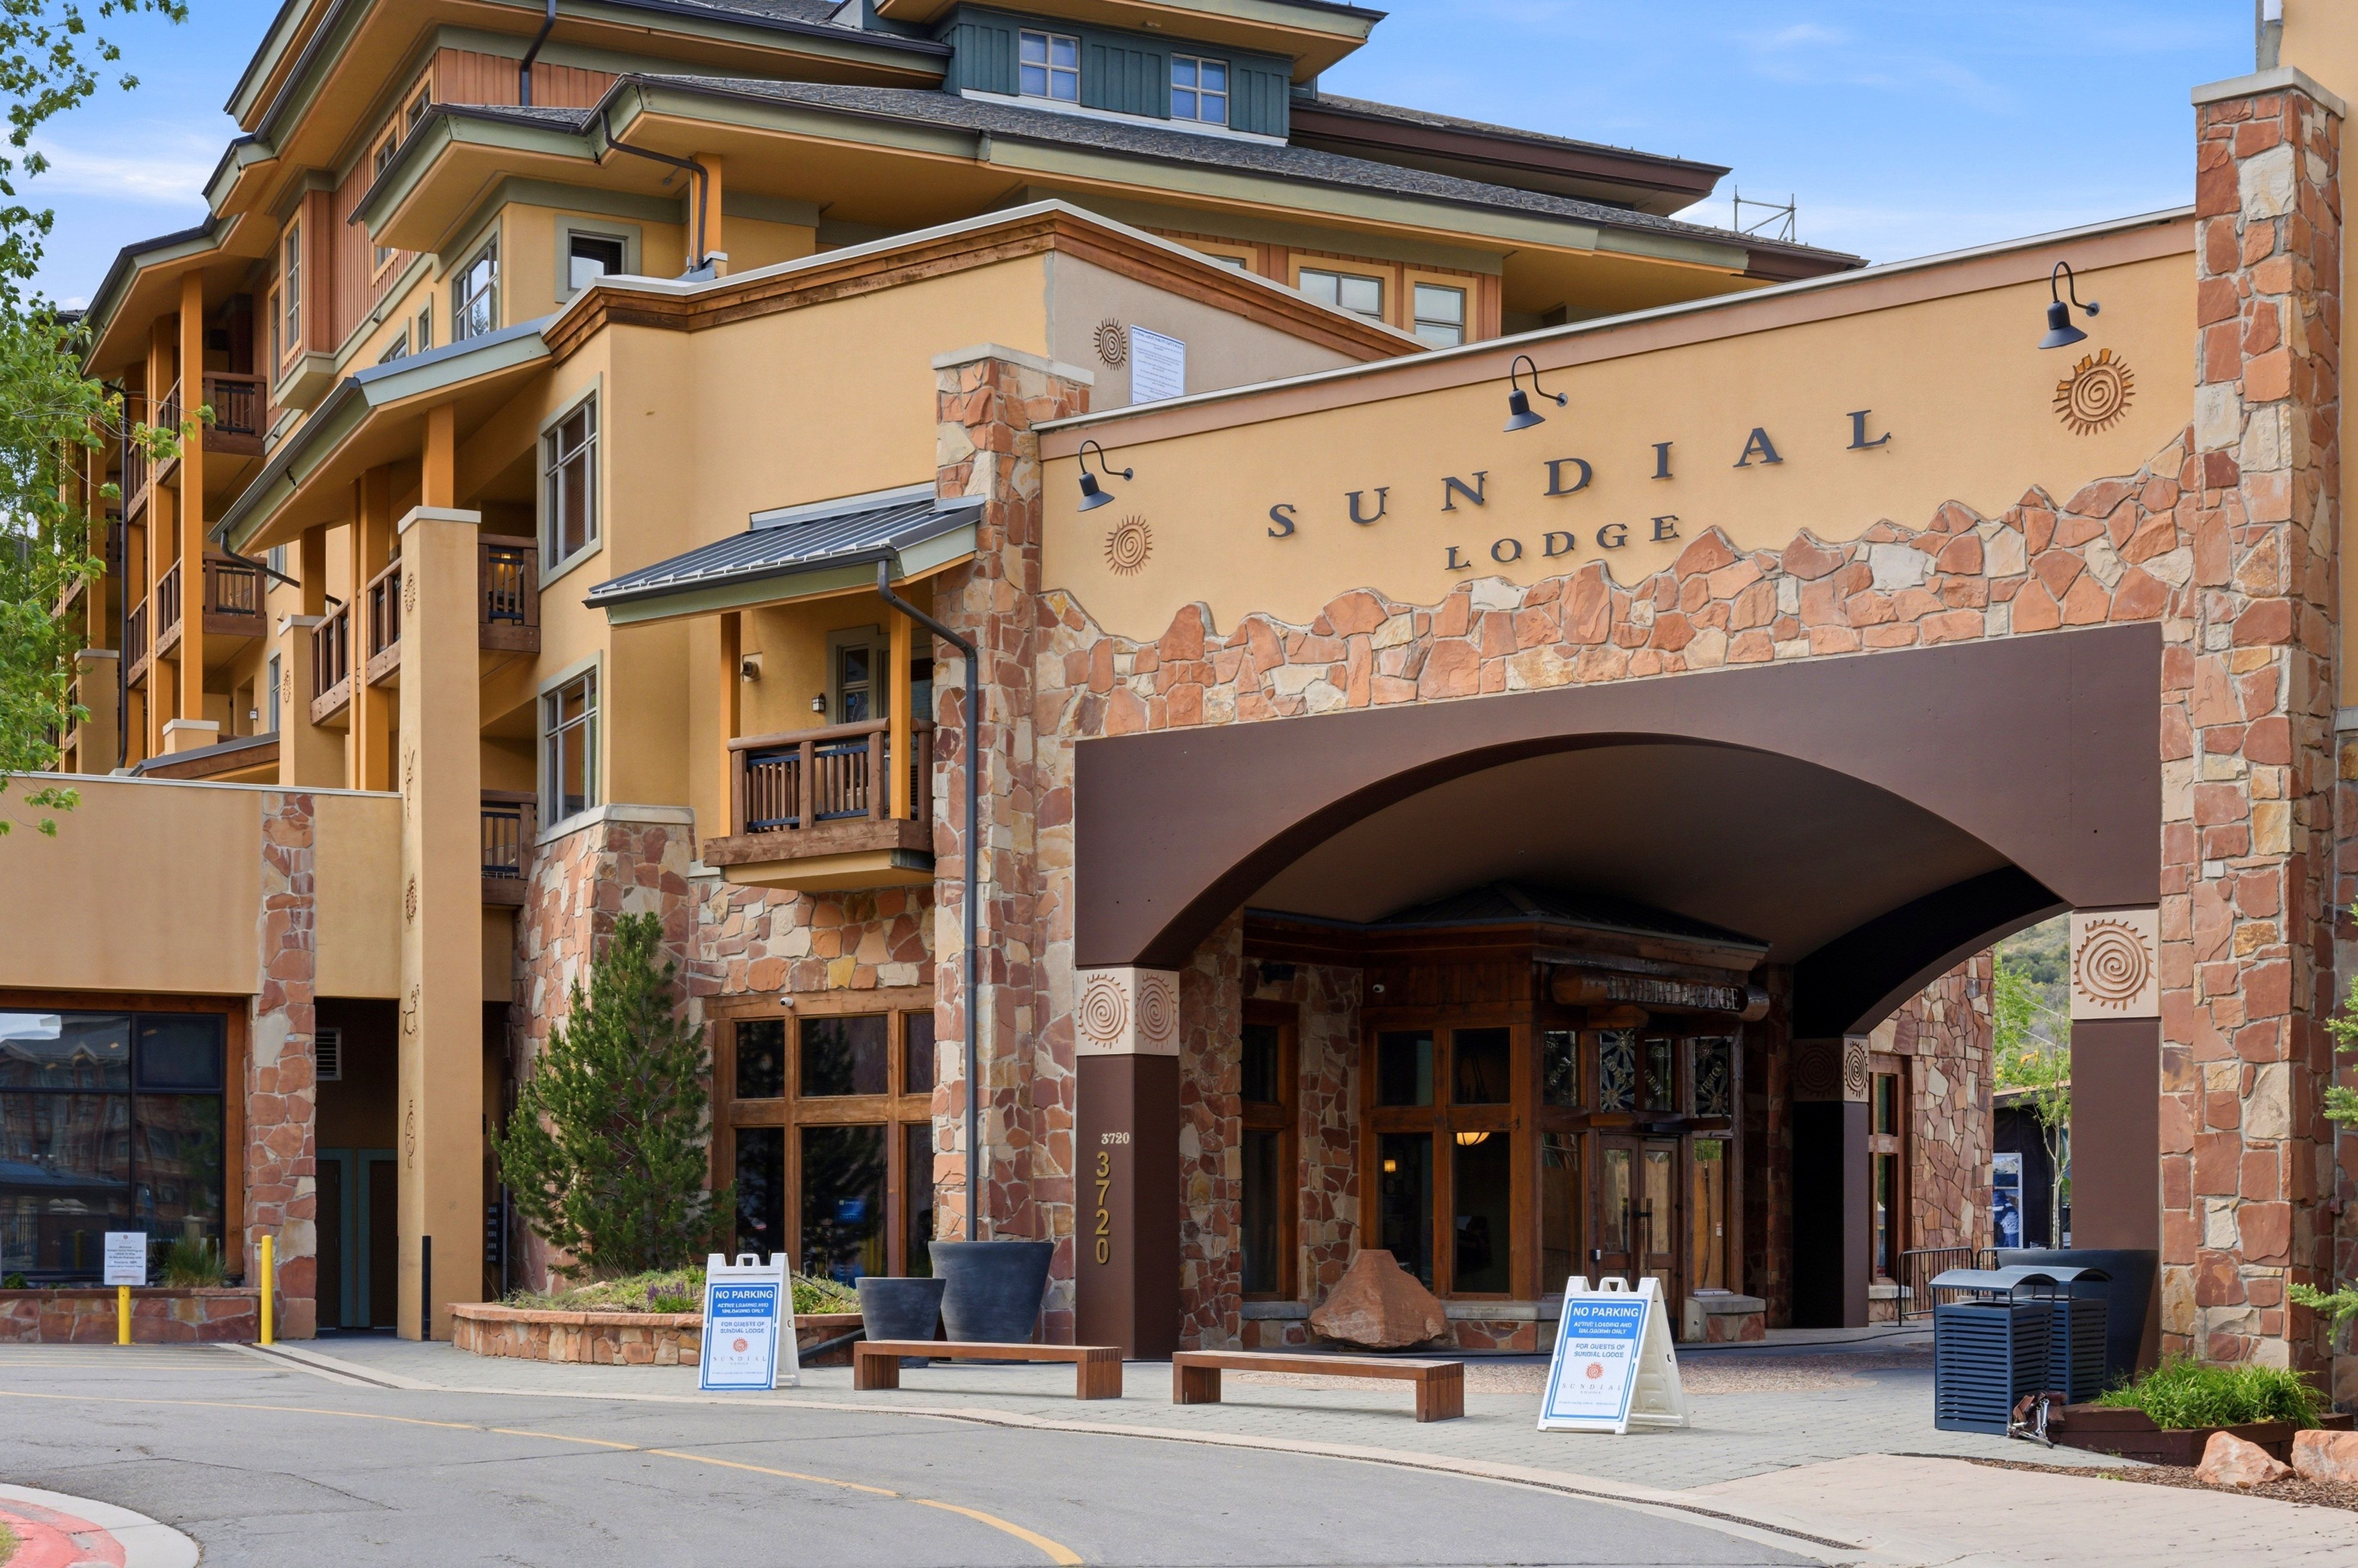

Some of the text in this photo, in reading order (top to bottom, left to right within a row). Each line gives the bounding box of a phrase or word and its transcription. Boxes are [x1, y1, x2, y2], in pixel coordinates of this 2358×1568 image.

[1268, 409, 1892, 538] SUNDIAL
[1445, 515, 1679, 571] LODGE
[1685, 983, 1740, 1011] LODGE
[1101, 1132, 1130, 1145] 3720
[1095, 1151, 1110, 1264] 3720
[732, 1290, 773, 1299] PARKING
[1573, 1307, 1639, 1317] NO PARKING
[1562, 1383, 1622, 1391] SUNDIAL
